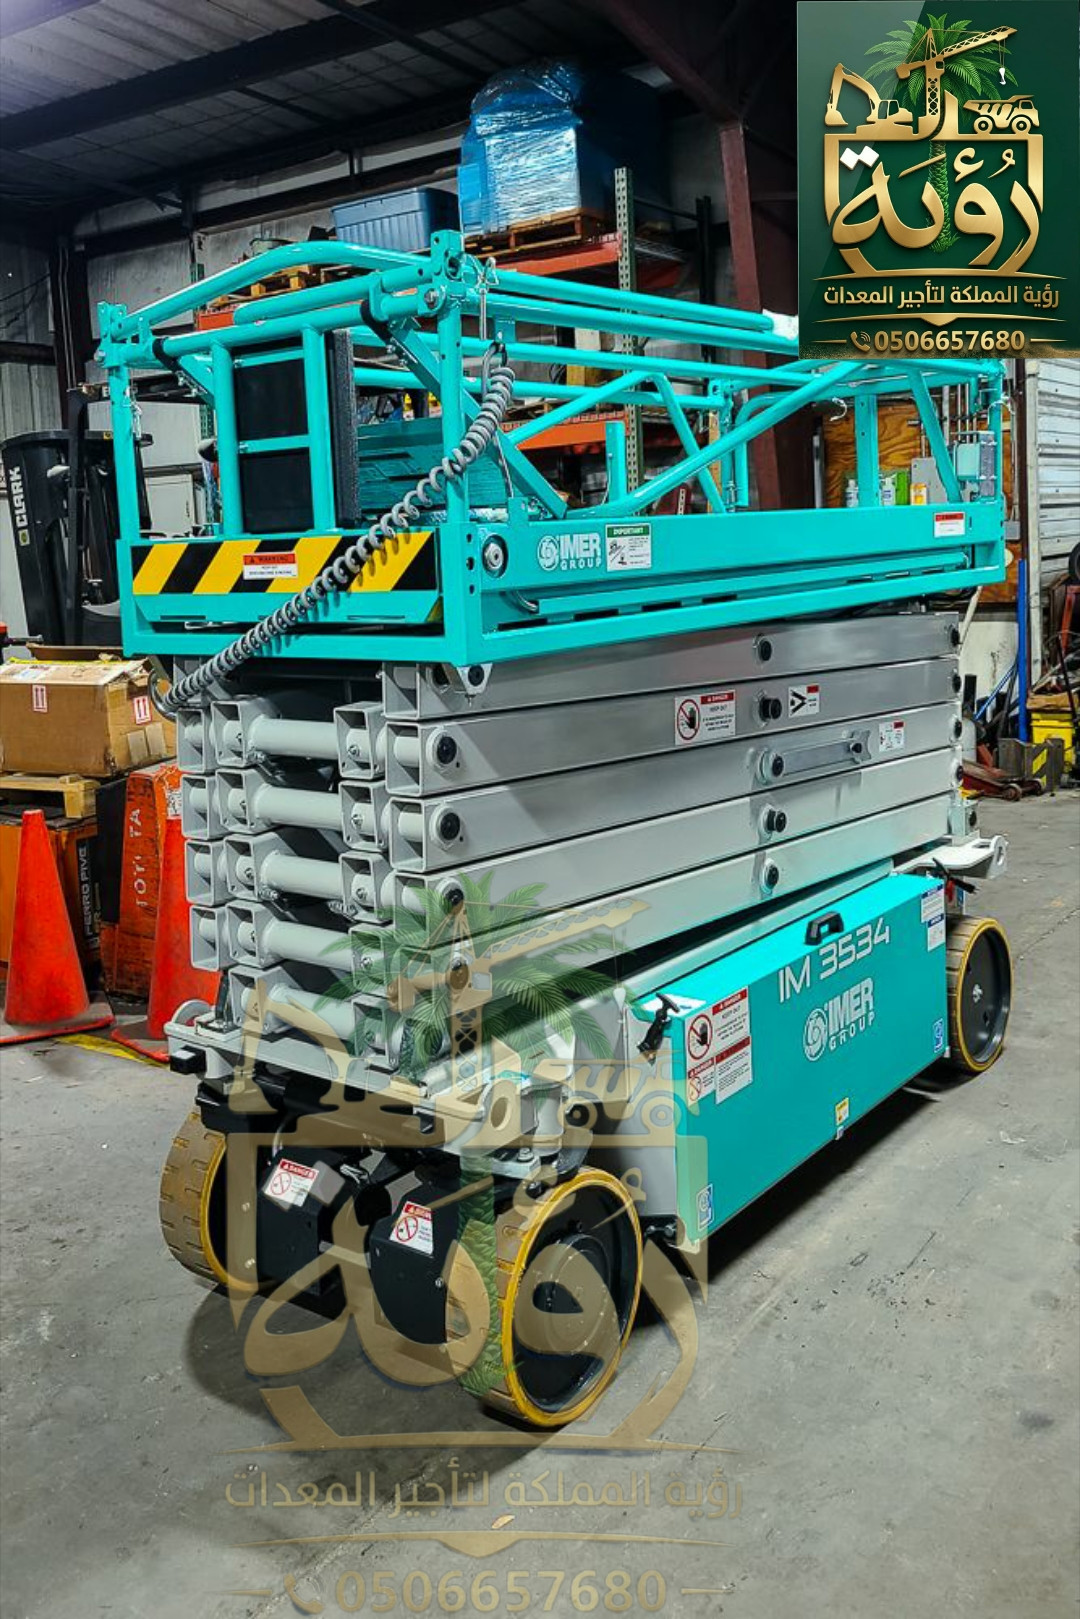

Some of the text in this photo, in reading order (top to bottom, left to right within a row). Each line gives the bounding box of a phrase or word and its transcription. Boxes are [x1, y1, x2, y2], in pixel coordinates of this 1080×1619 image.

[8, 465, 29, 529] CLARK
[559, 532, 602, 560] IMER
[560, 556, 602, 571] GROUP
[778, 917, 890, 1004] IM 3534
[826, 977, 874, 1037] IMER
[828, 1011, 875, 1051] GROUP
